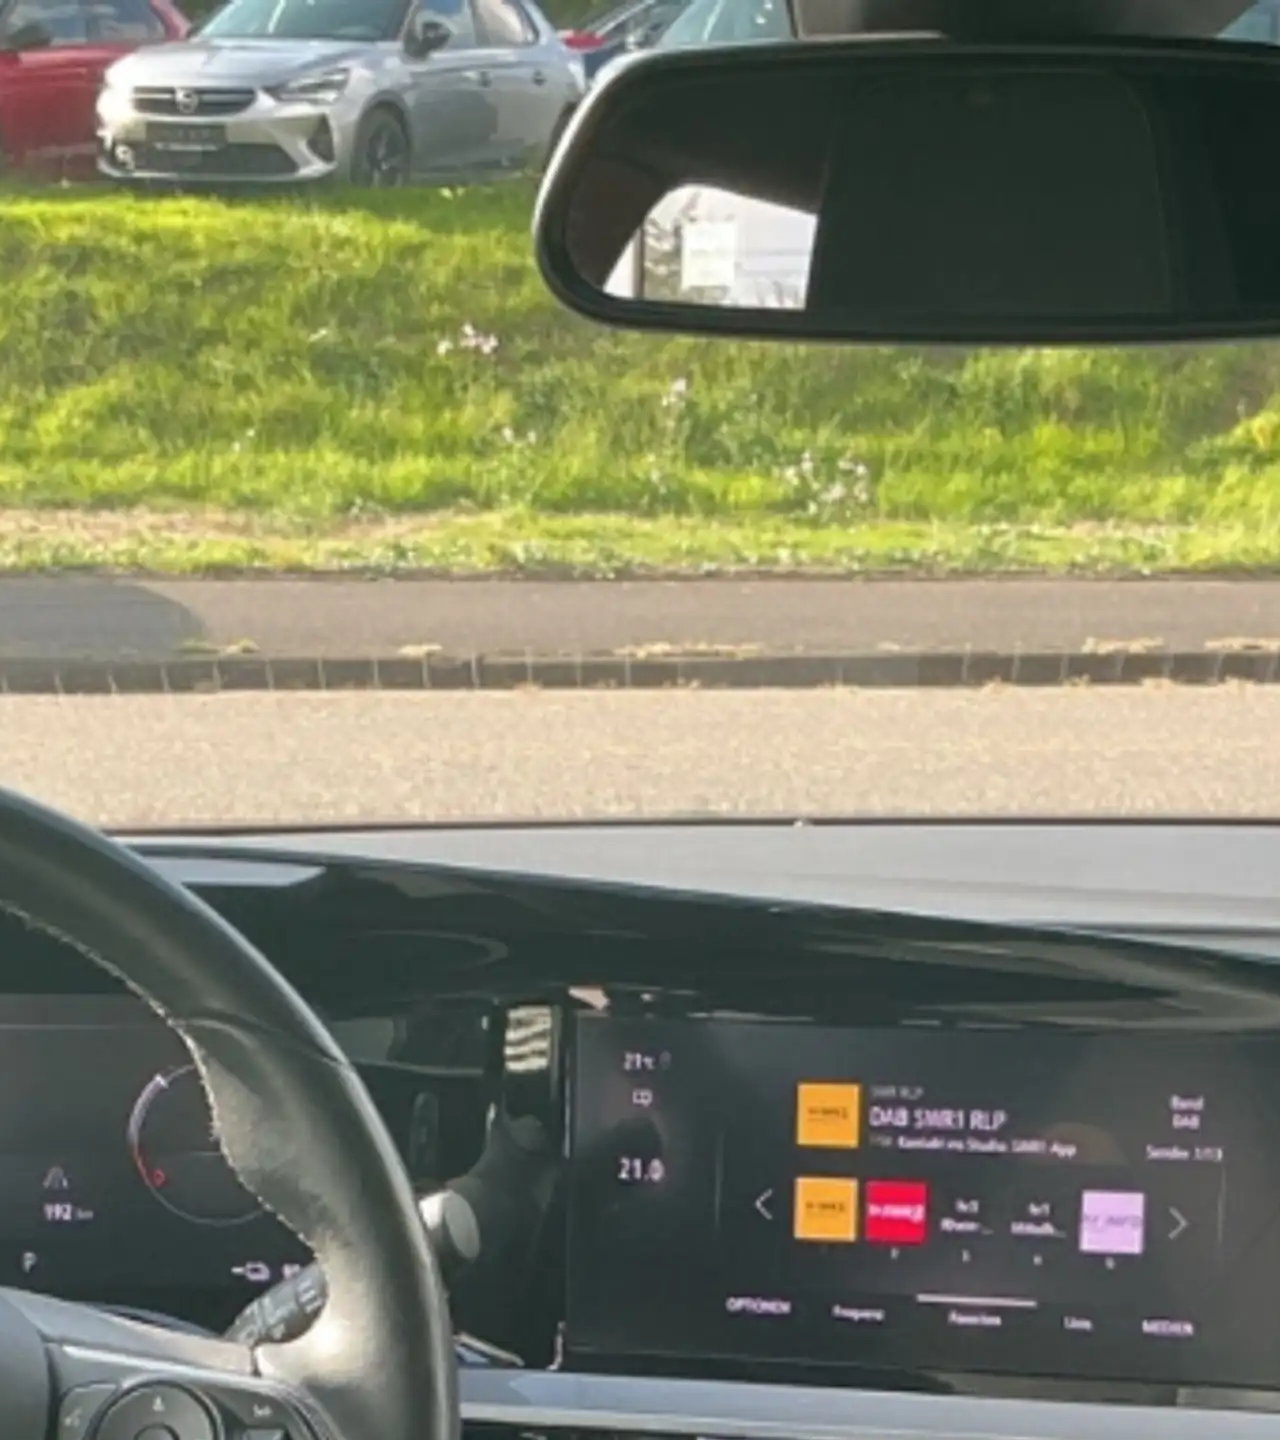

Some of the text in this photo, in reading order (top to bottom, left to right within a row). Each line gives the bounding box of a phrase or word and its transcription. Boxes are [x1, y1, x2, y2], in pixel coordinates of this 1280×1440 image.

[869, 1106, 908, 1127] DAB
[969, 1109, 1008, 1131] RLP
[618, 1156, 665, 1183] 21.0
